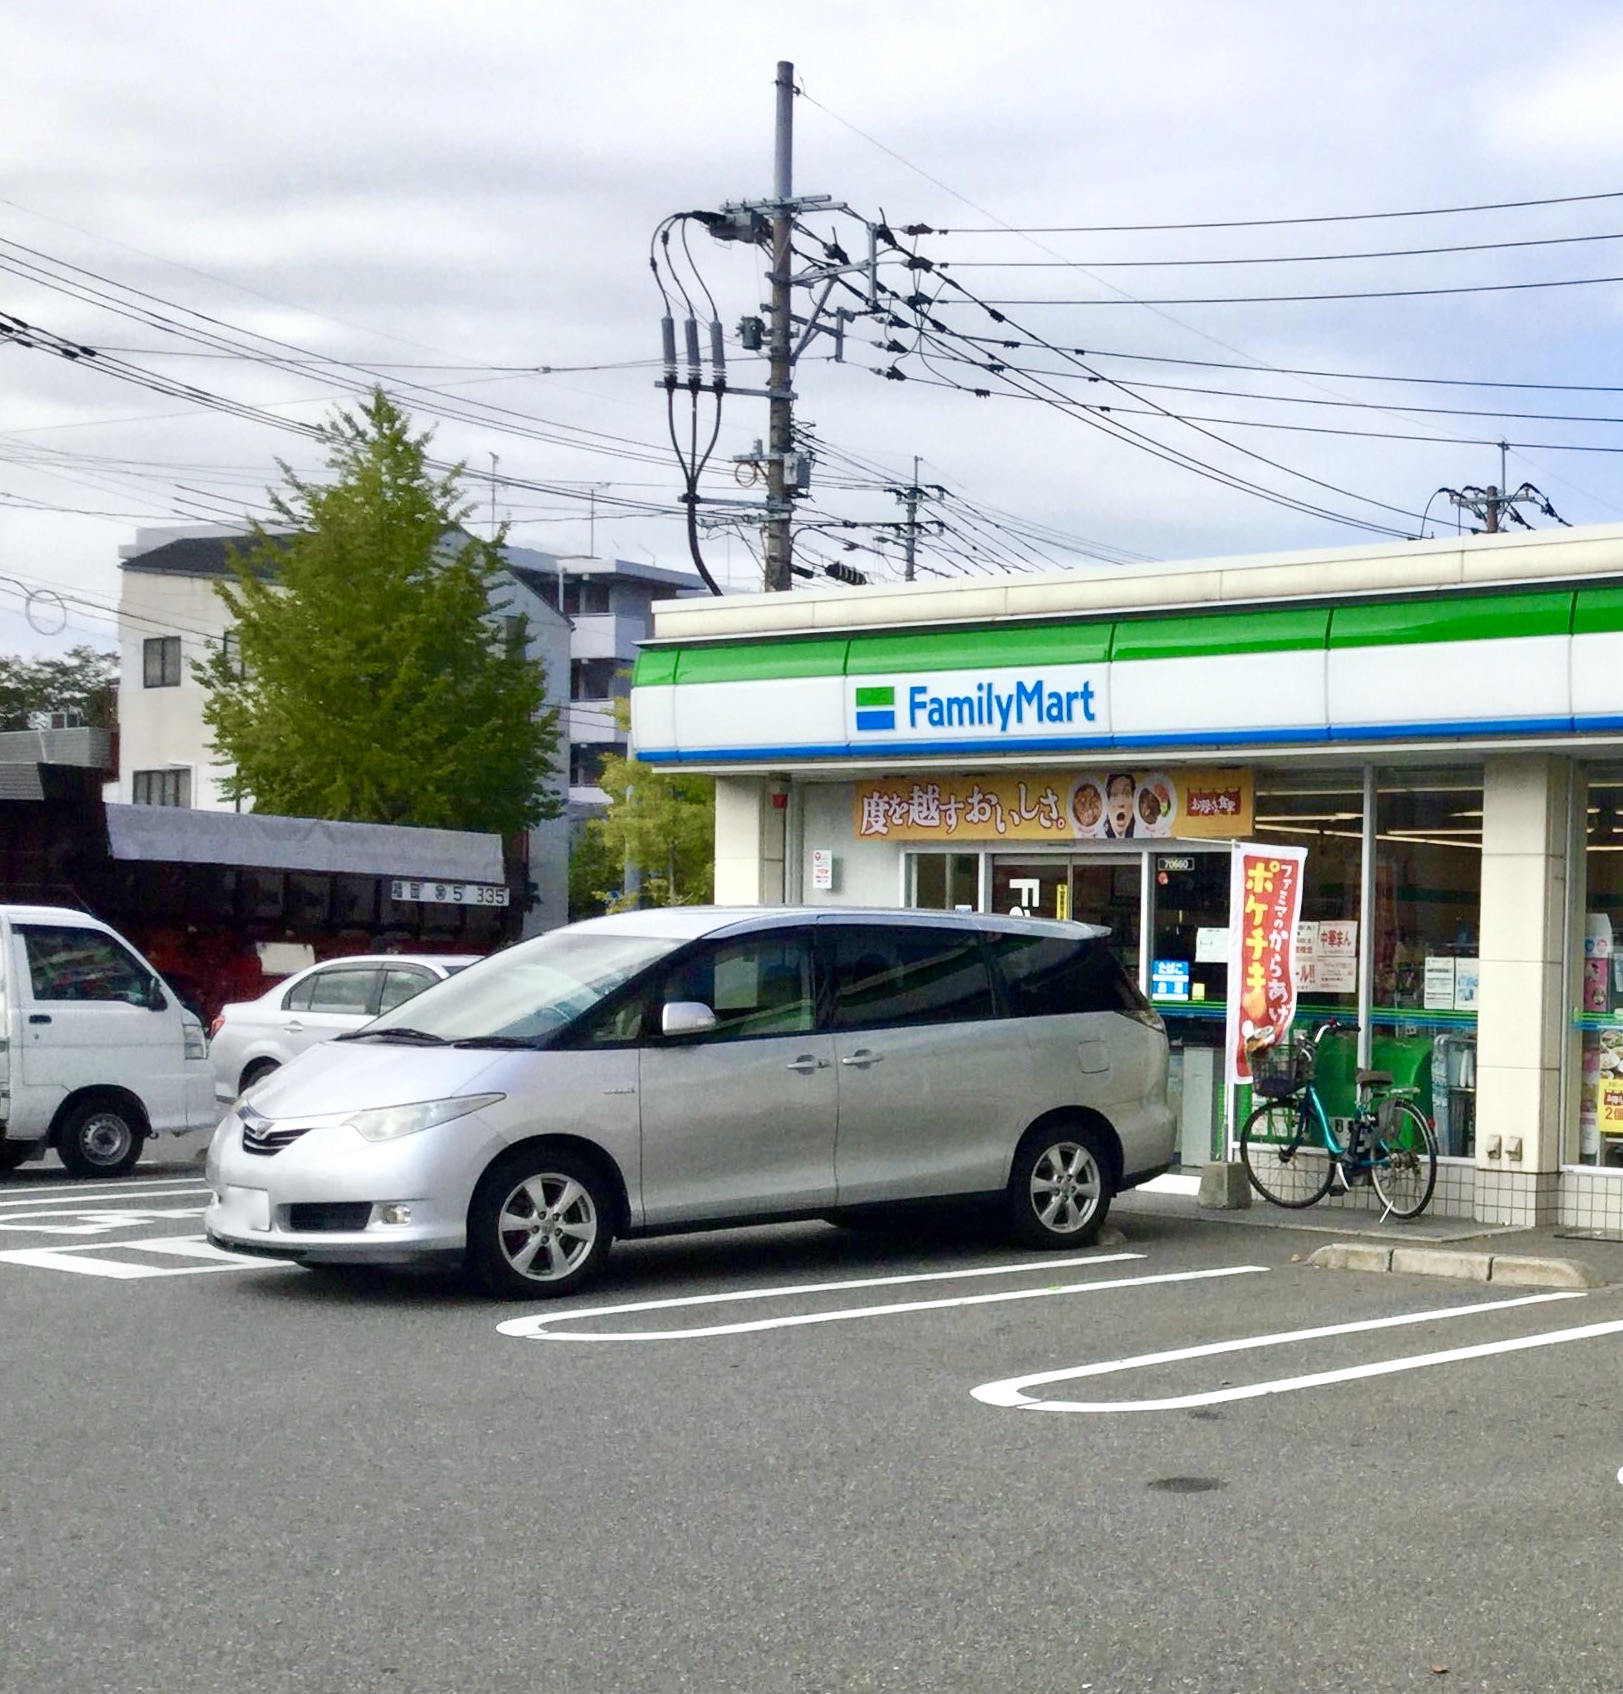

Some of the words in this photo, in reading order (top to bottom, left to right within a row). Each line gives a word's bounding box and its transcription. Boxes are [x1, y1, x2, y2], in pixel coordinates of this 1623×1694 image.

[909, 680, 1096, 732] FamilyMart
[860, 783, 1066, 835] 度を越すおいしさ。
[453, 886, 463, 902] 5
[1245, 860, 1280, 993] ポケチキ
[1268, 863, 1293, 1022] ファミマのからあげ
